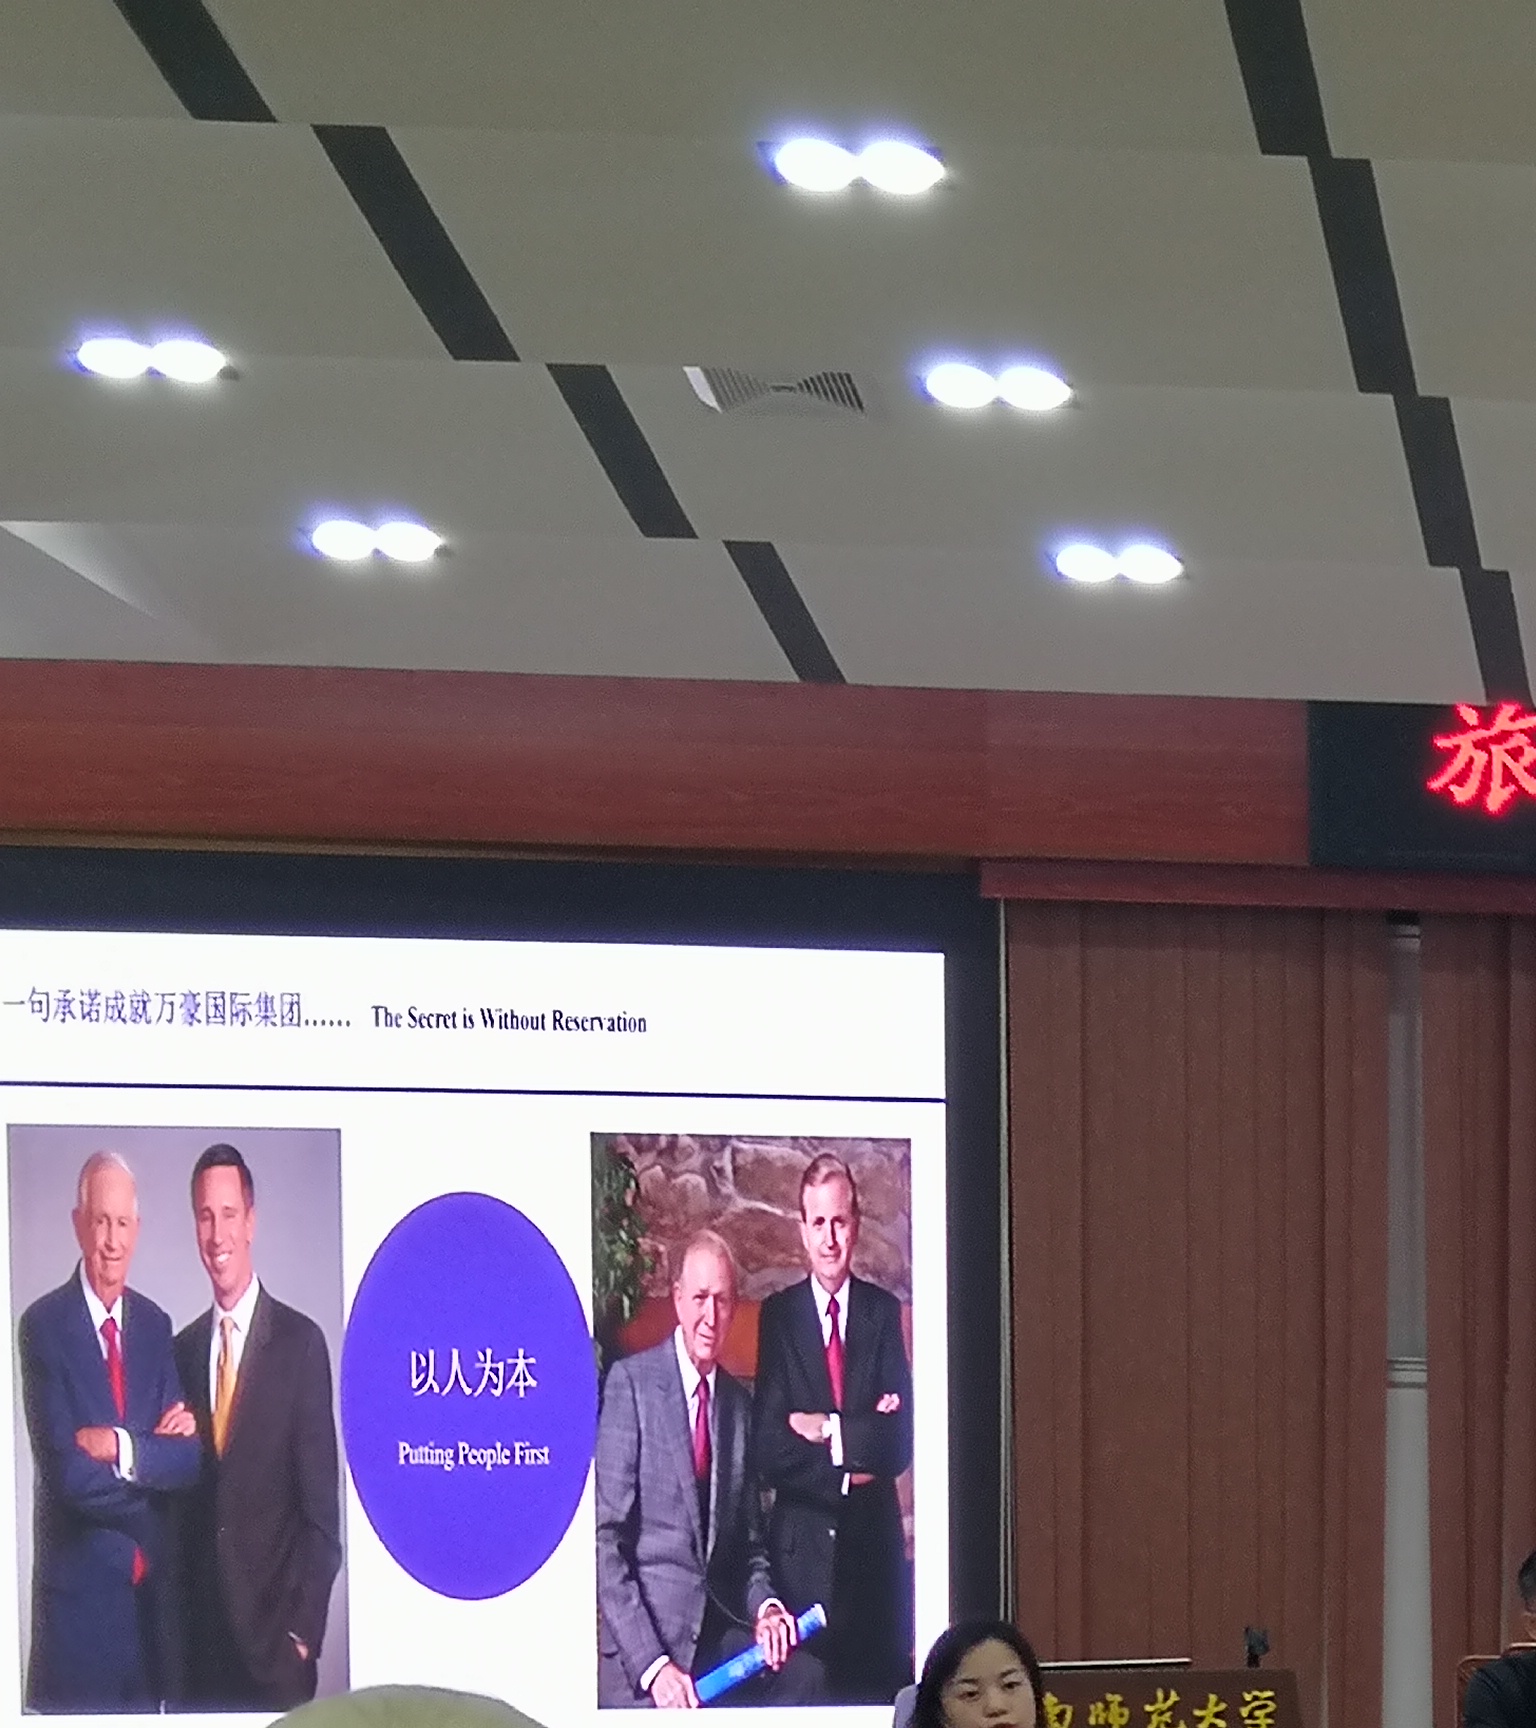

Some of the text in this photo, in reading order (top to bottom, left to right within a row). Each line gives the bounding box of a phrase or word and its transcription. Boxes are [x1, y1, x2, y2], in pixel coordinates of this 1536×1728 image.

[371, 1005, 647, 1033] The Secret is Without Reservation
[410, 1347, 538, 1398] 以人为本
[398, 1441, 550, 1471] Putting People First
